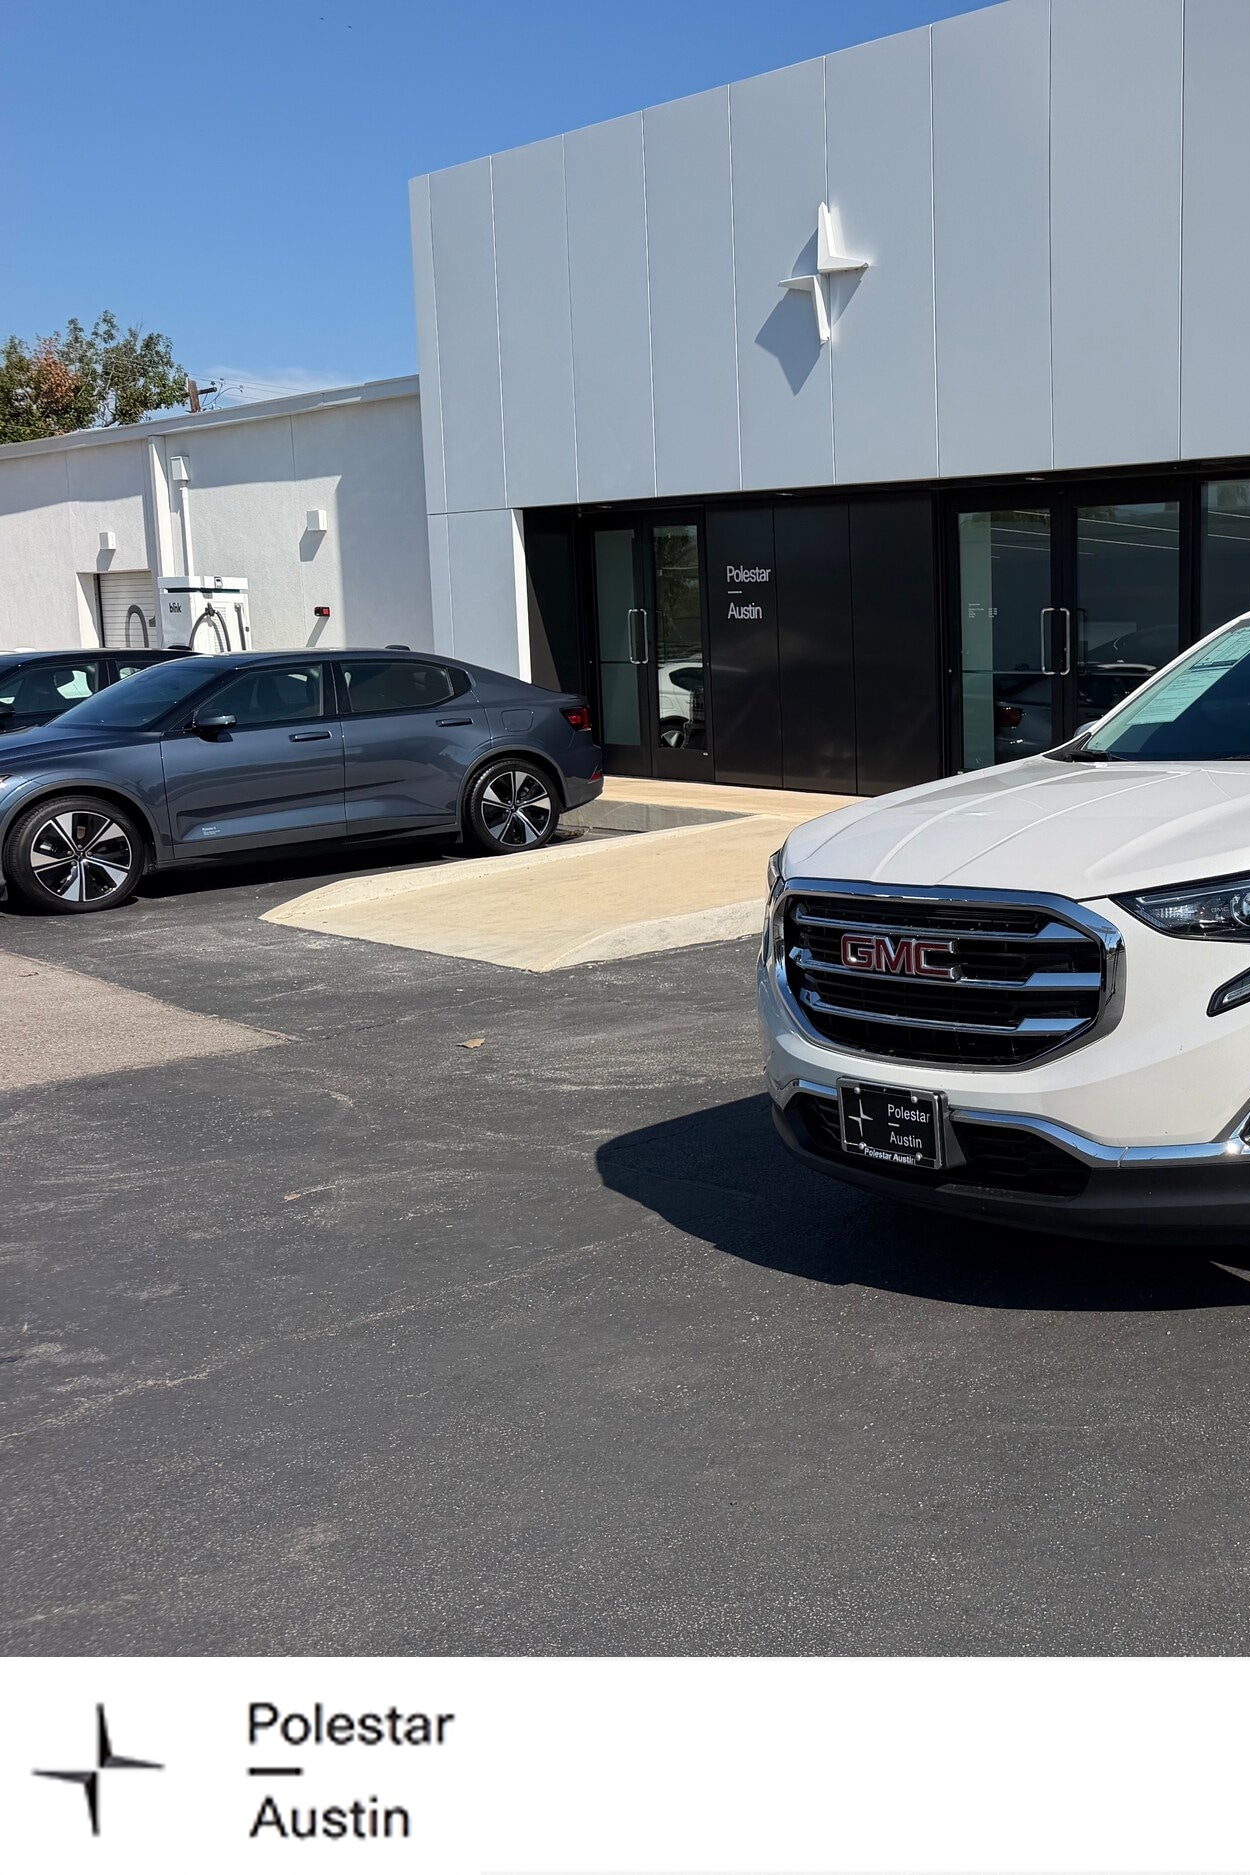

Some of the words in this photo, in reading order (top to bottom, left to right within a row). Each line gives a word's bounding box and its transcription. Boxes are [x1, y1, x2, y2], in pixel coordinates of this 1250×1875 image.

[727, 565, 771, 582] Polestar
[728, 602, 762, 619] Austin
[841, 932, 960, 980] GMC
[887, 1103, 931, 1123] Polestar
[890, 1131, 922, 1149] Austin
[864, 1147, 892, 1160] Polestar
[893, 1153, 916, 1165] Austin
